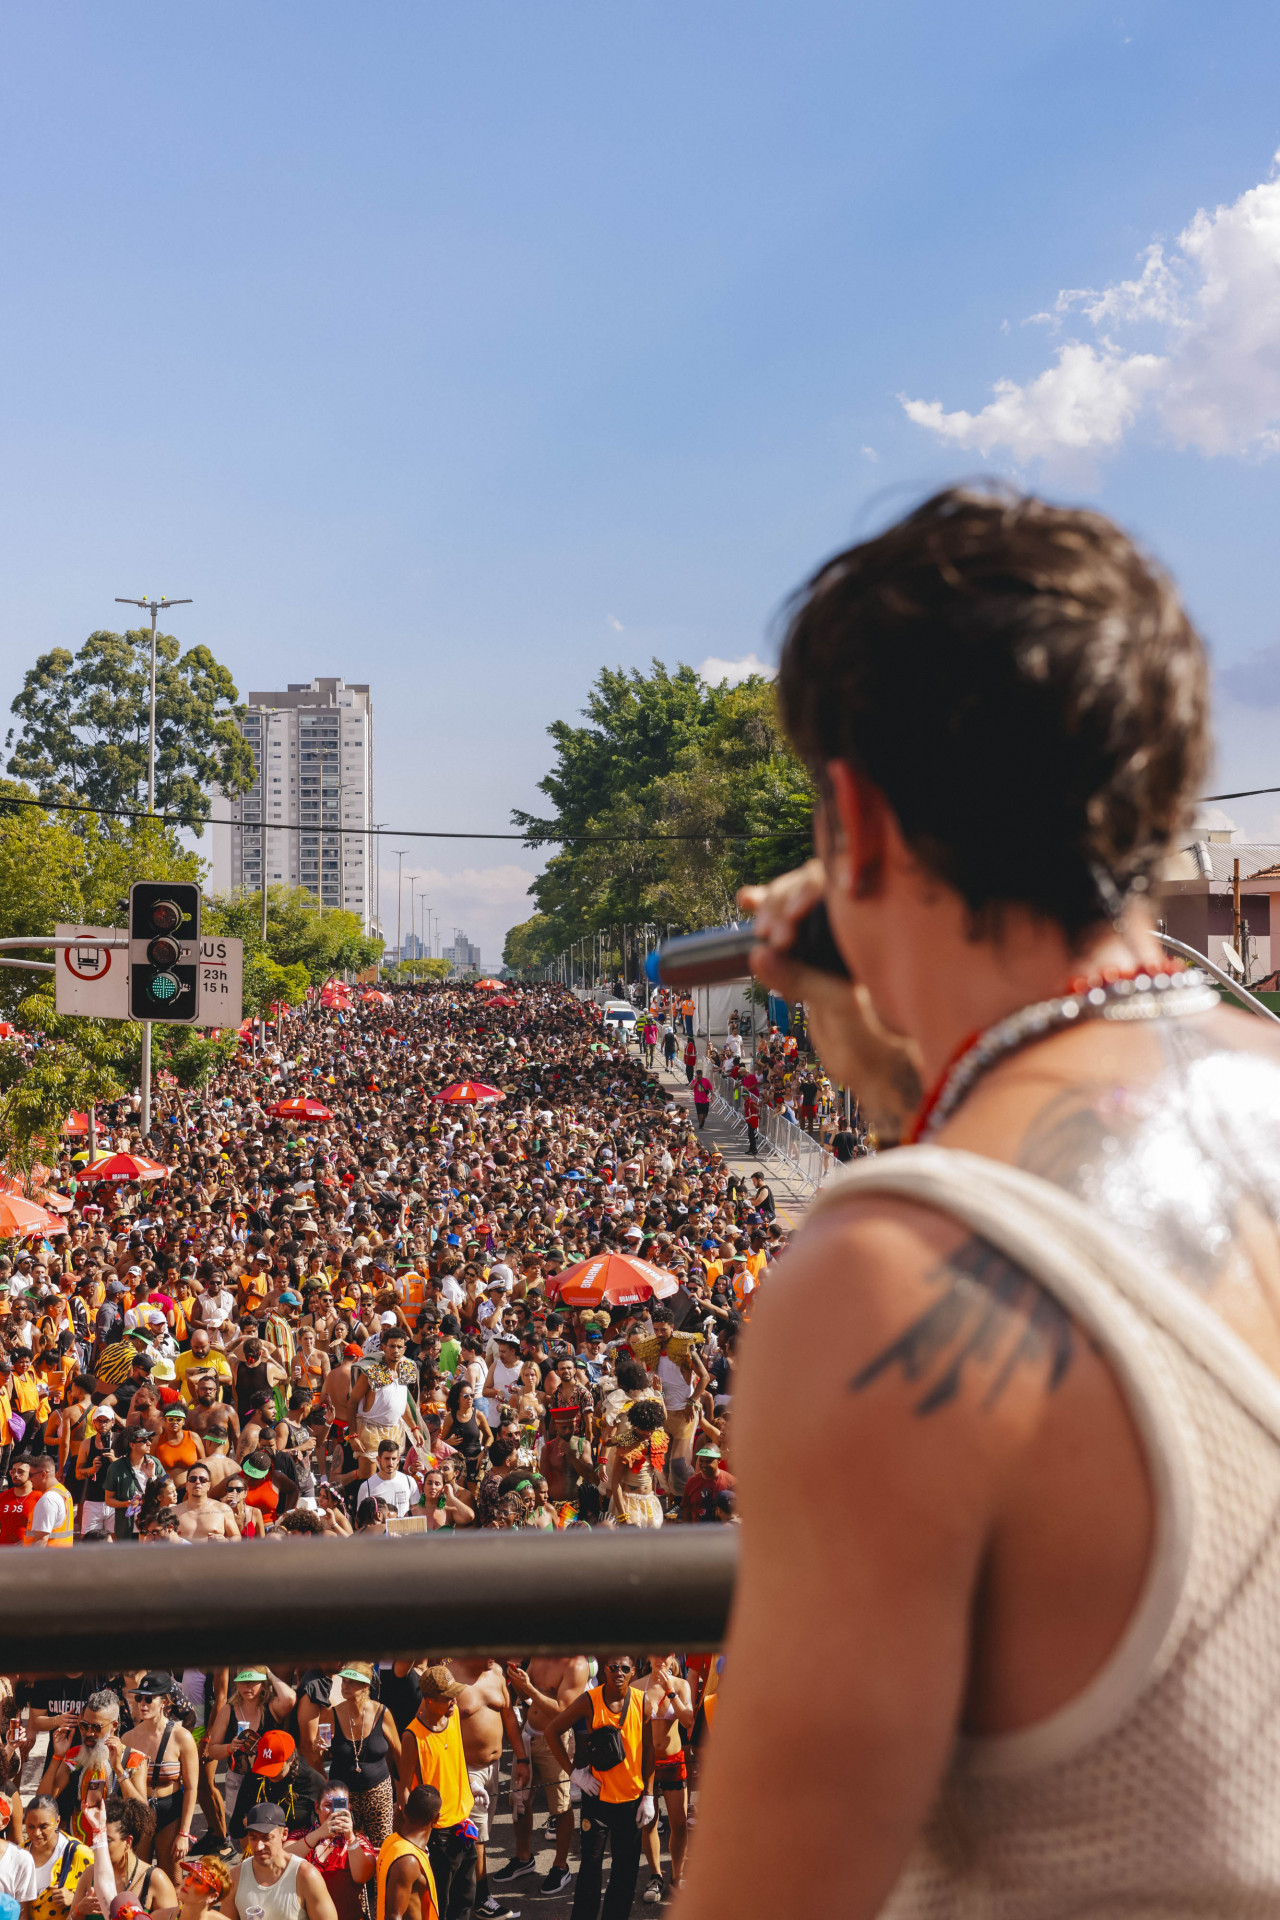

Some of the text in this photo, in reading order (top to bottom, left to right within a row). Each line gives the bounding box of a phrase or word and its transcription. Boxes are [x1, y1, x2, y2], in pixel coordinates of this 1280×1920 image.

[200, 942, 227, 958] US
[203, 969, 227, 980] 23h
[580, 1263, 604, 1289] BRAHMA
[629, 1258, 663, 1281] BRAHMA
[618, 1294, 640, 1303] BRAHMA
